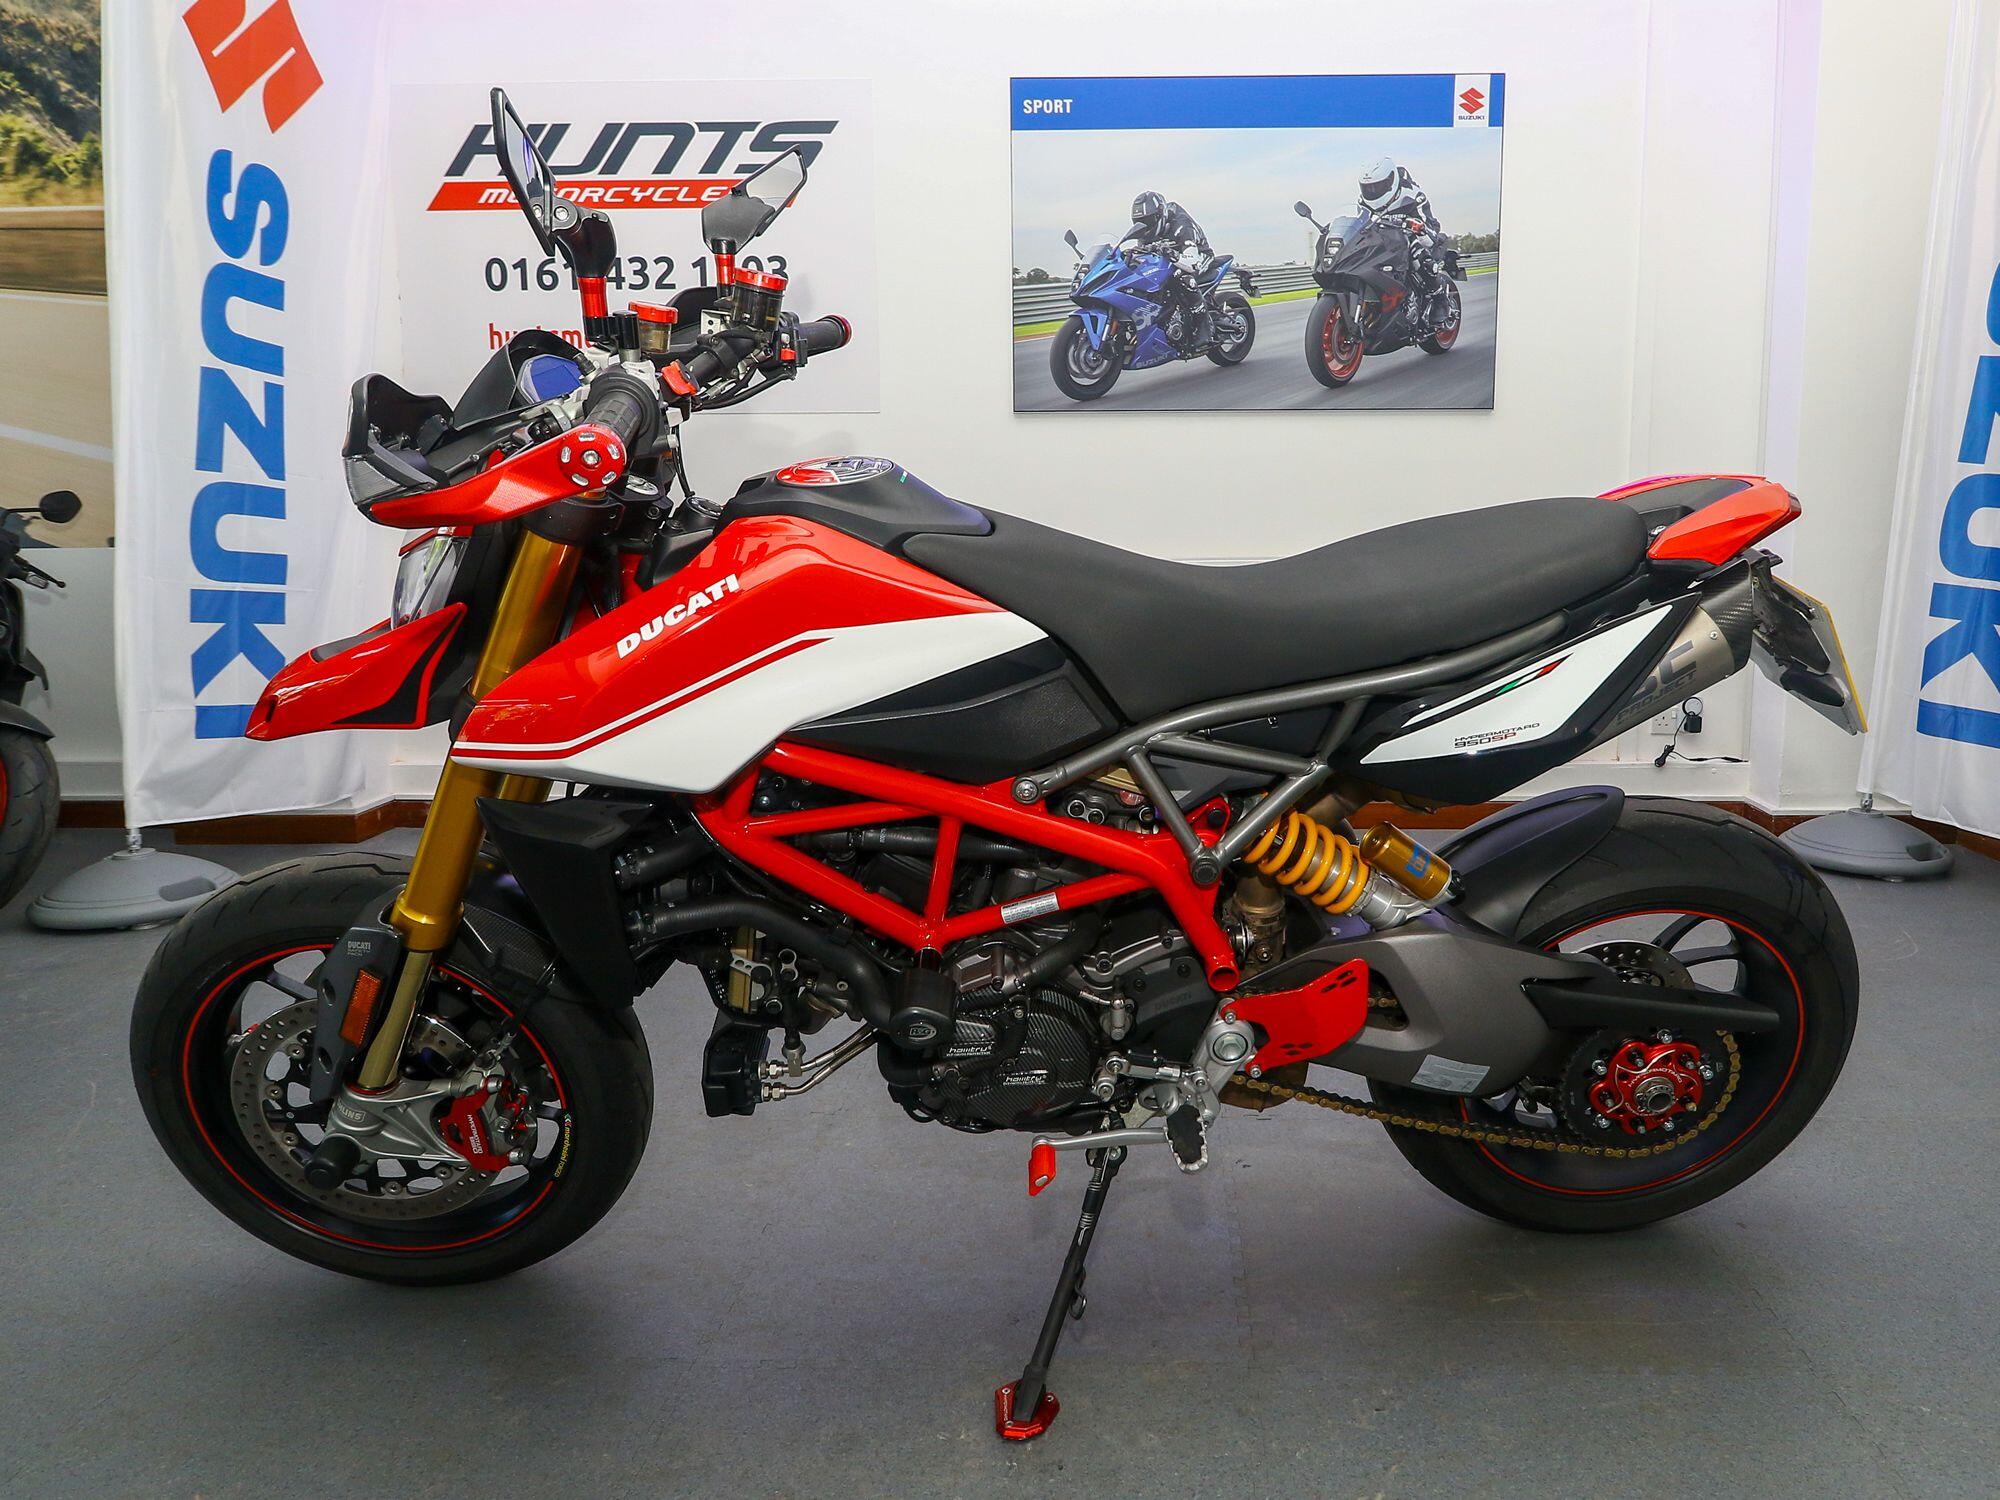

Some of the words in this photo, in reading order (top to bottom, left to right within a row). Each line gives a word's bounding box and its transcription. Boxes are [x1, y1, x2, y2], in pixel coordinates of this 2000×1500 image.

[1022, 98, 1074, 114] SPORT
[478, 186, 733, 205] MORCYCLE
[605, 255, 676, 290] 432
[691, 255, 789, 288] 13
[1136, 353, 1169, 368] SUZUKI
[190, 148, 290, 740] SUZUKI
[616, 573, 741, 659] DUCATI
[1454, 722, 1541, 742] HYPERMOTARD
[1454, 732, 1517, 749] 950SP
